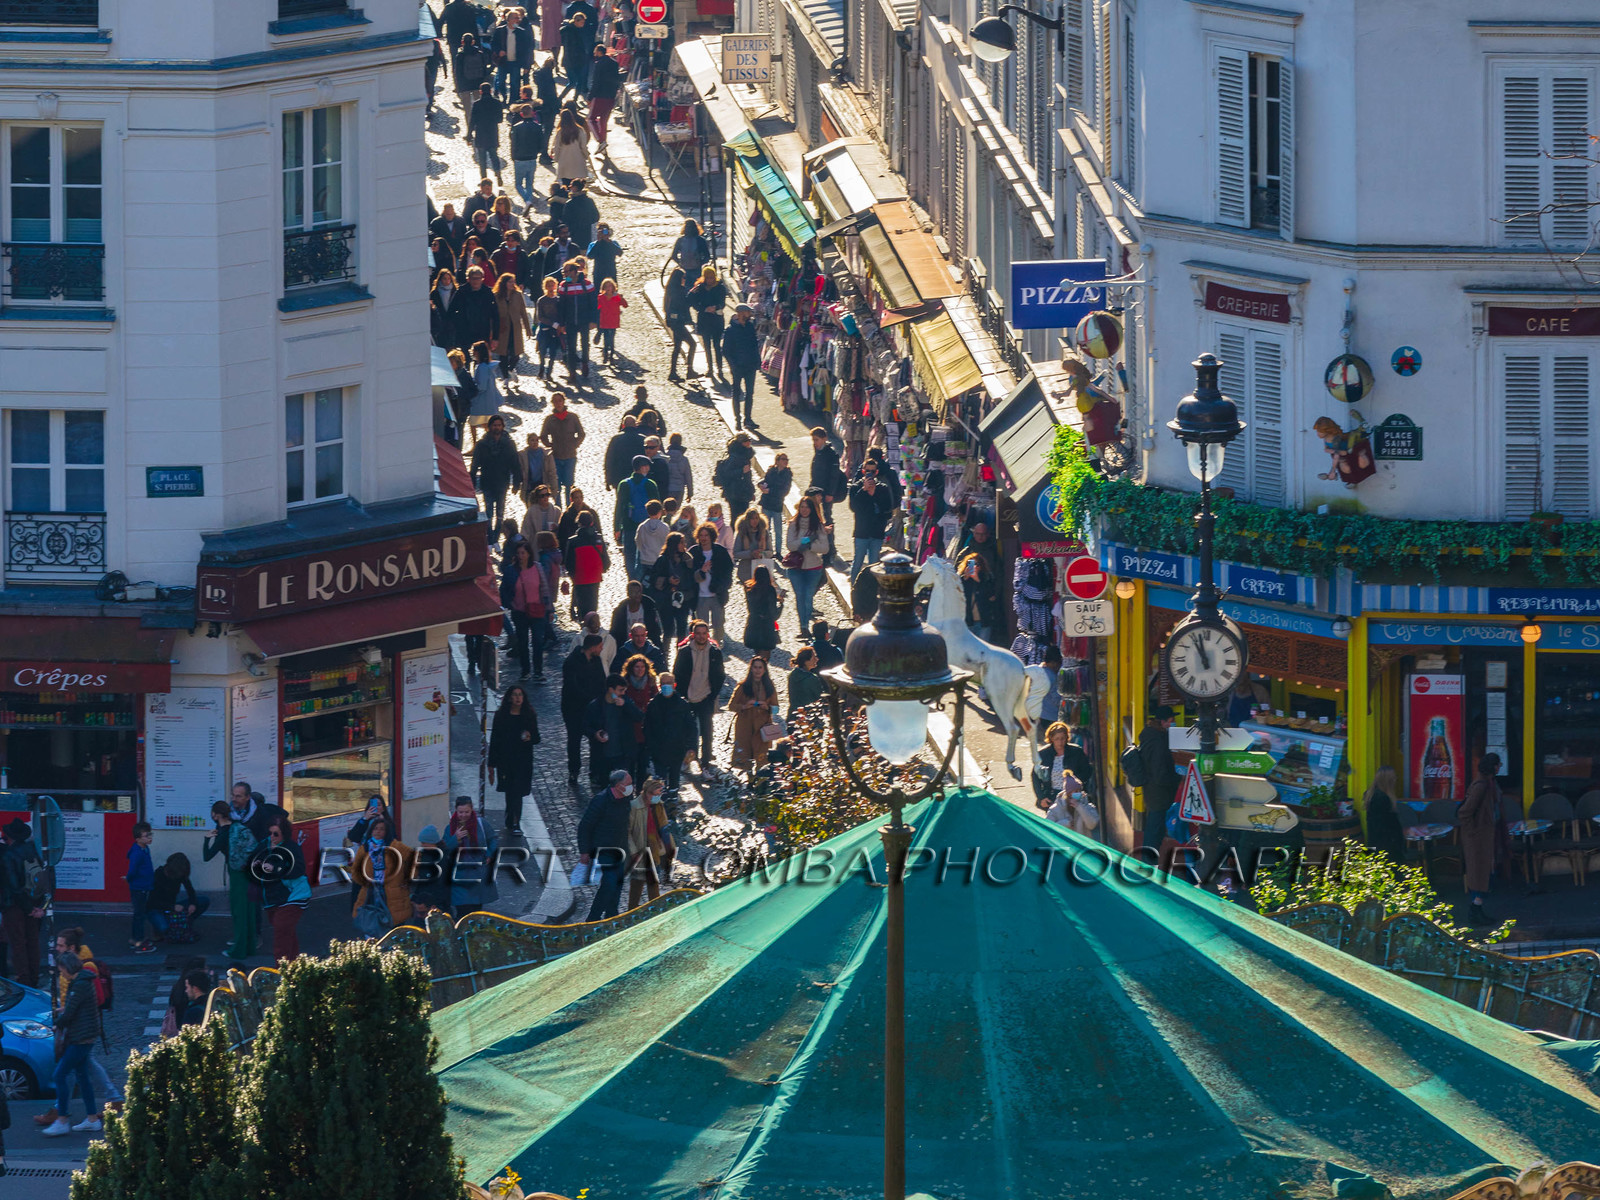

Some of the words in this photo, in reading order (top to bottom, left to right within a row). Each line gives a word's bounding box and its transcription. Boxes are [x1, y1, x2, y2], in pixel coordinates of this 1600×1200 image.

[725, 39, 769, 51] GALERIES
[736, 53, 758, 66] DES
[726, 68, 768, 80] TISSUS
[1020, 285, 1099, 306] PIZZA
[1217, 295, 1280, 318] CREPERIE
[1526, 317, 1571, 332] CAFE
[1384, 431, 1413, 439] PLACE
[1381, 448, 1415, 456] PIERRE
[160, 473, 191, 481] PLACE
[164, 483, 197, 491] PIERRE
[258, 571, 296, 610] LE
[308, 536, 467, 601] RONSARD
[1121, 555, 1178, 579] PIZZA
[1240, 577, 1286, 596] CREPE
[1076, 604, 1102, 613] SAUF
[1248, 609, 1313, 634] Sandwichs
[13, 668, 108, 691] Crêpes
[1226, 759, 1261, 769] toilettes
